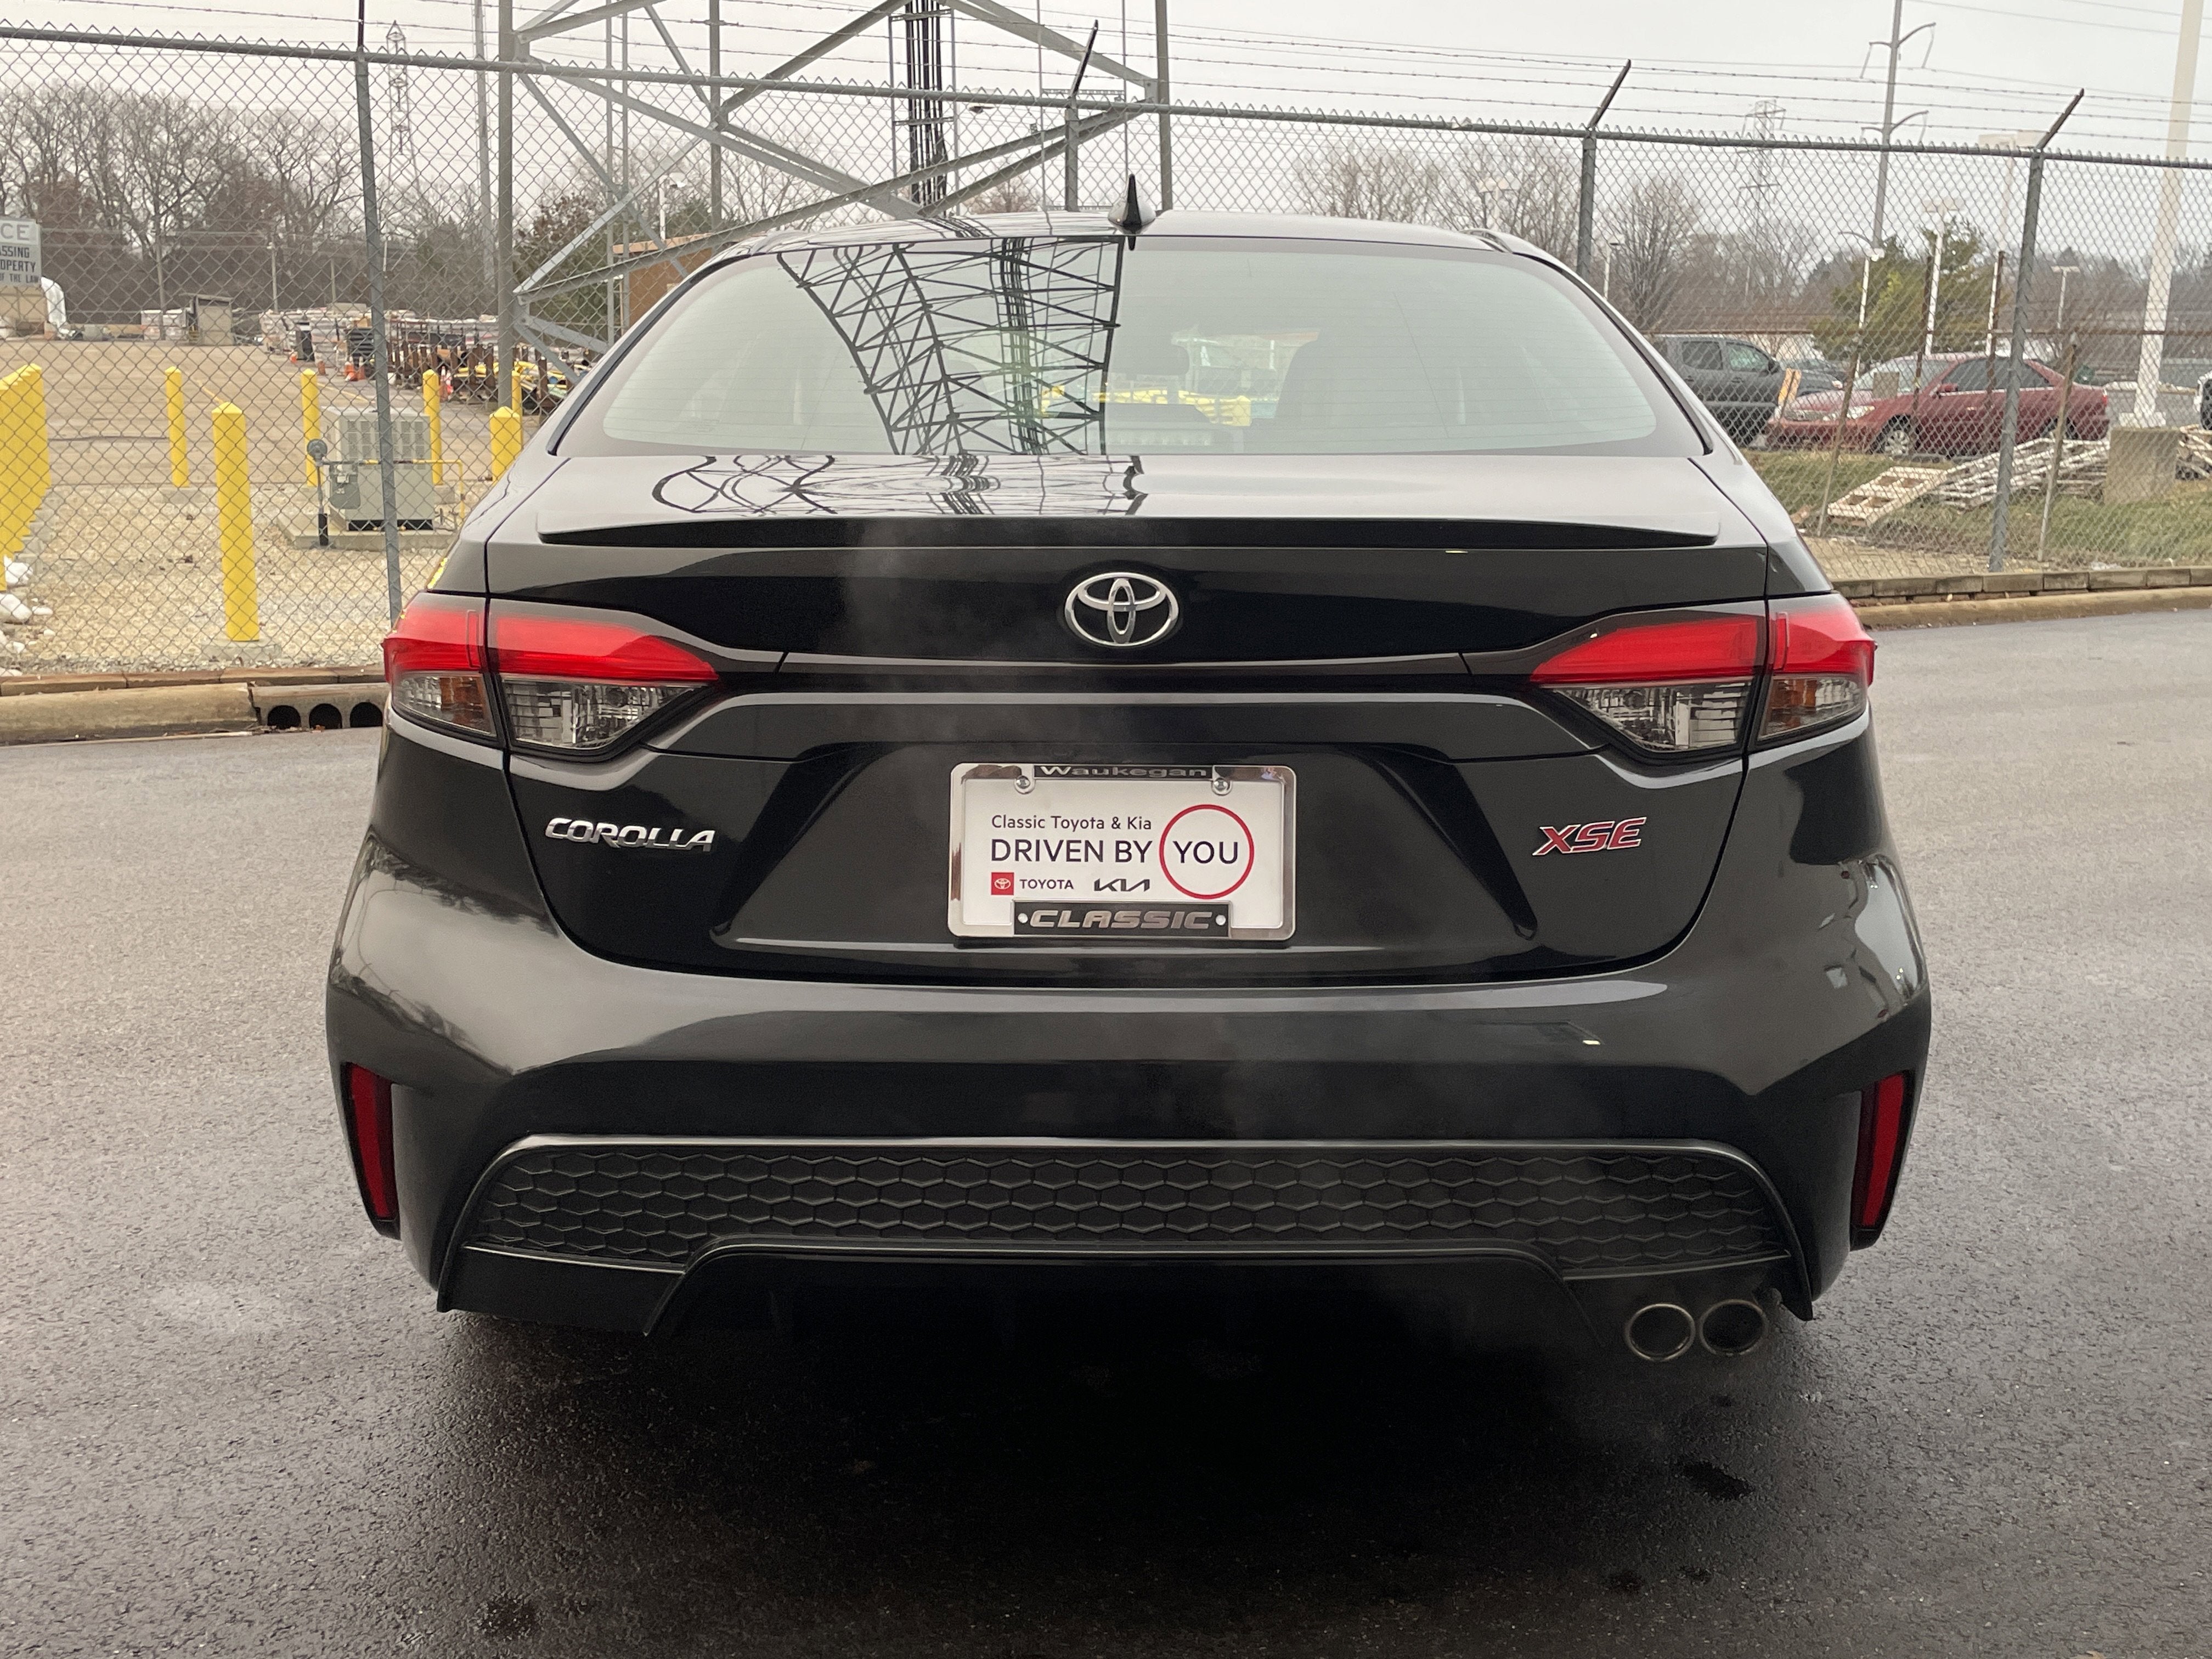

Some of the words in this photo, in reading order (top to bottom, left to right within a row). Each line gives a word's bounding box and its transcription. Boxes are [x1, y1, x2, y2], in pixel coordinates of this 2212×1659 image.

[1040, 766, 1206, 777] Waukegan
[991, 815, 1045, 829] Classic
[1051, 816, 1104, 832] Toyota
[1111, 817, 1121, 829] &
[1127, 817, 1152, 830] Kia
[545, 817, 715, 852] COROLLA
[1532, 816, 1647, 856] XSE
[991, 839, 1104, 862] DRIVEN
[1115, 840, 1153, 863] BY
[1173, 841, 1238, 864] YOU
[1019, 879, 1074, 890] TOYOTA
[1030, 910, 1212, 929] CLASSIC
